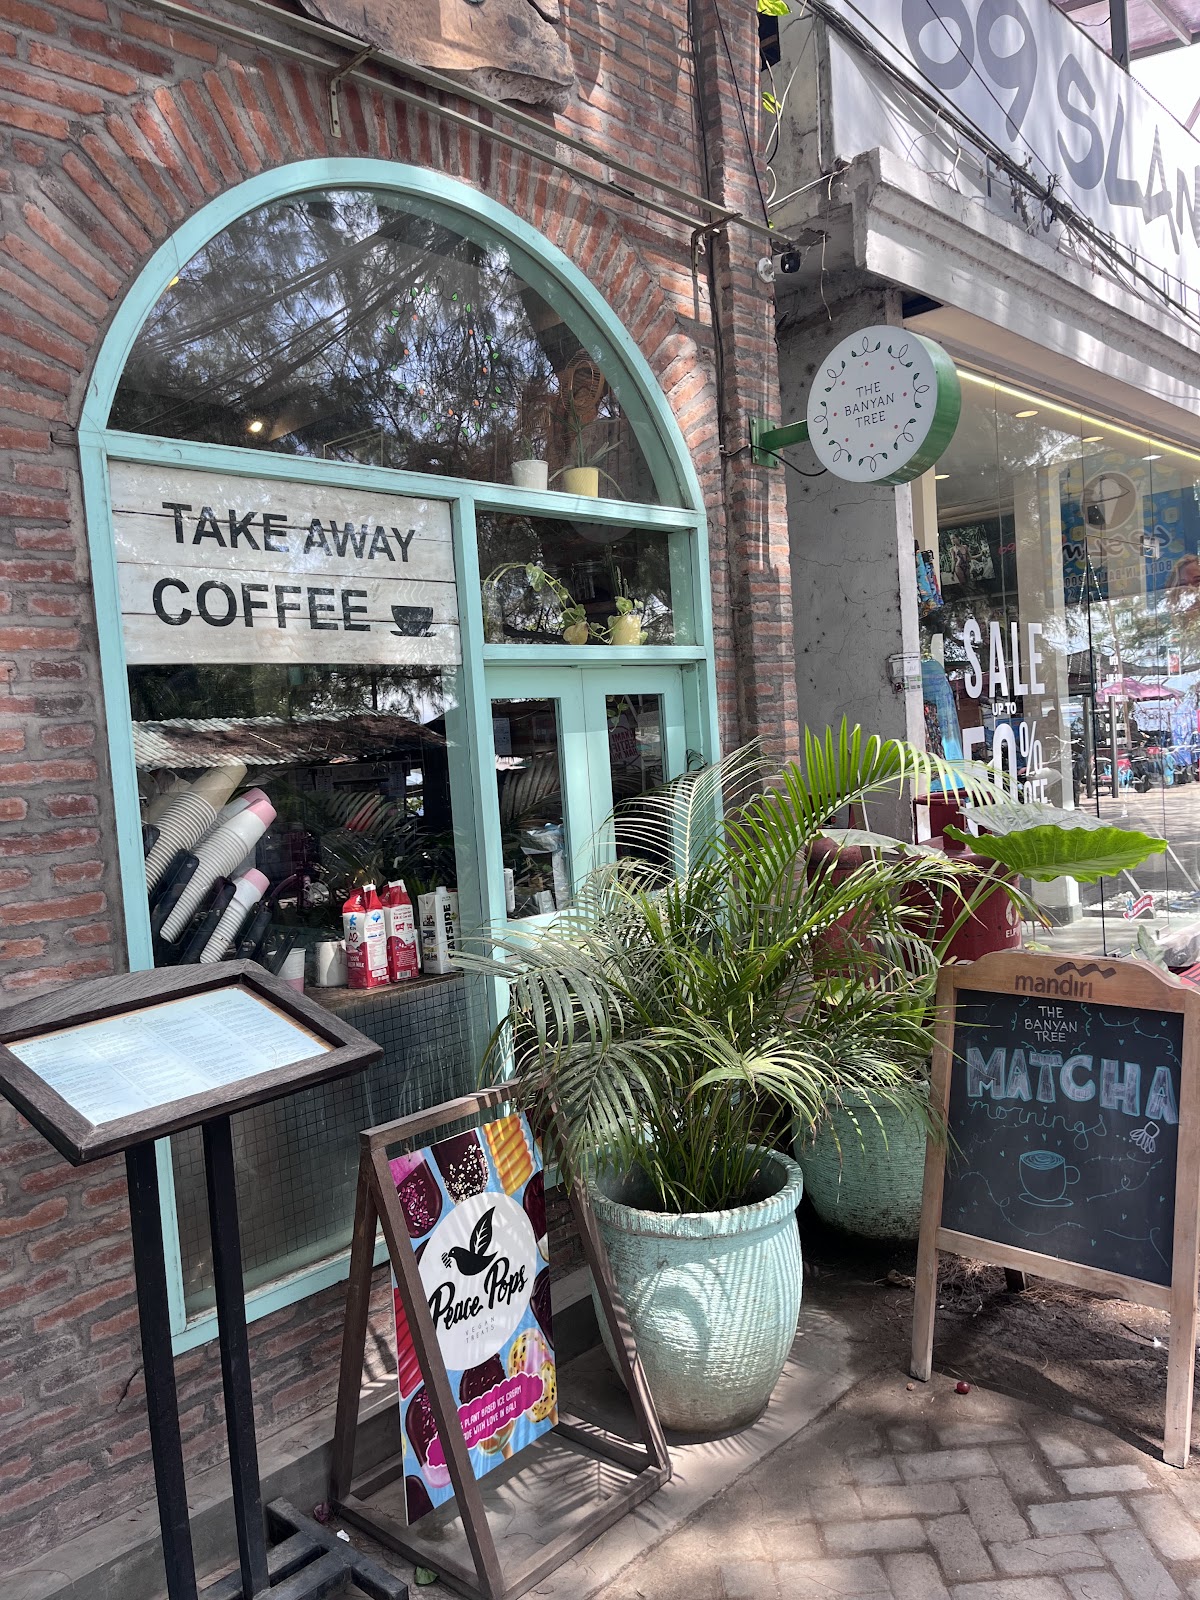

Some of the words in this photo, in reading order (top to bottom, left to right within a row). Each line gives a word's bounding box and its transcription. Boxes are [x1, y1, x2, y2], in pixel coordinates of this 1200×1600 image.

[856, 381, 881, 398] THE
[844, 393, 895, 416] BANYAN
[855, 411, 886, 428] TREE
[162, 502, 290, 552] TAKE
[303, 518, 416, 562] AWAY
[152, 577, 371, 632] COFFEE
[963, 618, 1045, 699] SALE
[992, 702, 1004, 716] UP
[1004, 701, 1017, 715] TO
[1015, 974, 1093, 999] mandiri
[1038, 1005, 1064, 1019] THE
[1024, 1019, 1078, 1033] BANYAN
[1035, 1030, 1067, 1042] TREE
[966, 1047, 1179, 1125] MATCHA
[968, 1100, 1107, 1150] mornings
[427, 1281, 484, 1330] Peace
[484, 1257, 528, 1310] Pops
[465, 1316, 495, 1336] VEGAN
[466, 1324, 495, 1344] TREATS
[464, 1411, 480, 1428] PLANT
[481, 1402, 496, 1418] BASED
[497, 1395, 505, 1407] ICE
[505, 1385, 522, 1401] CREAM
[473, 1421, 486, 1434] WITH
[486, 1412, 499, 1427] LOVE
[500, 1409, 505, 1418] IN
[505, 1400, 517, 1415] BALI
